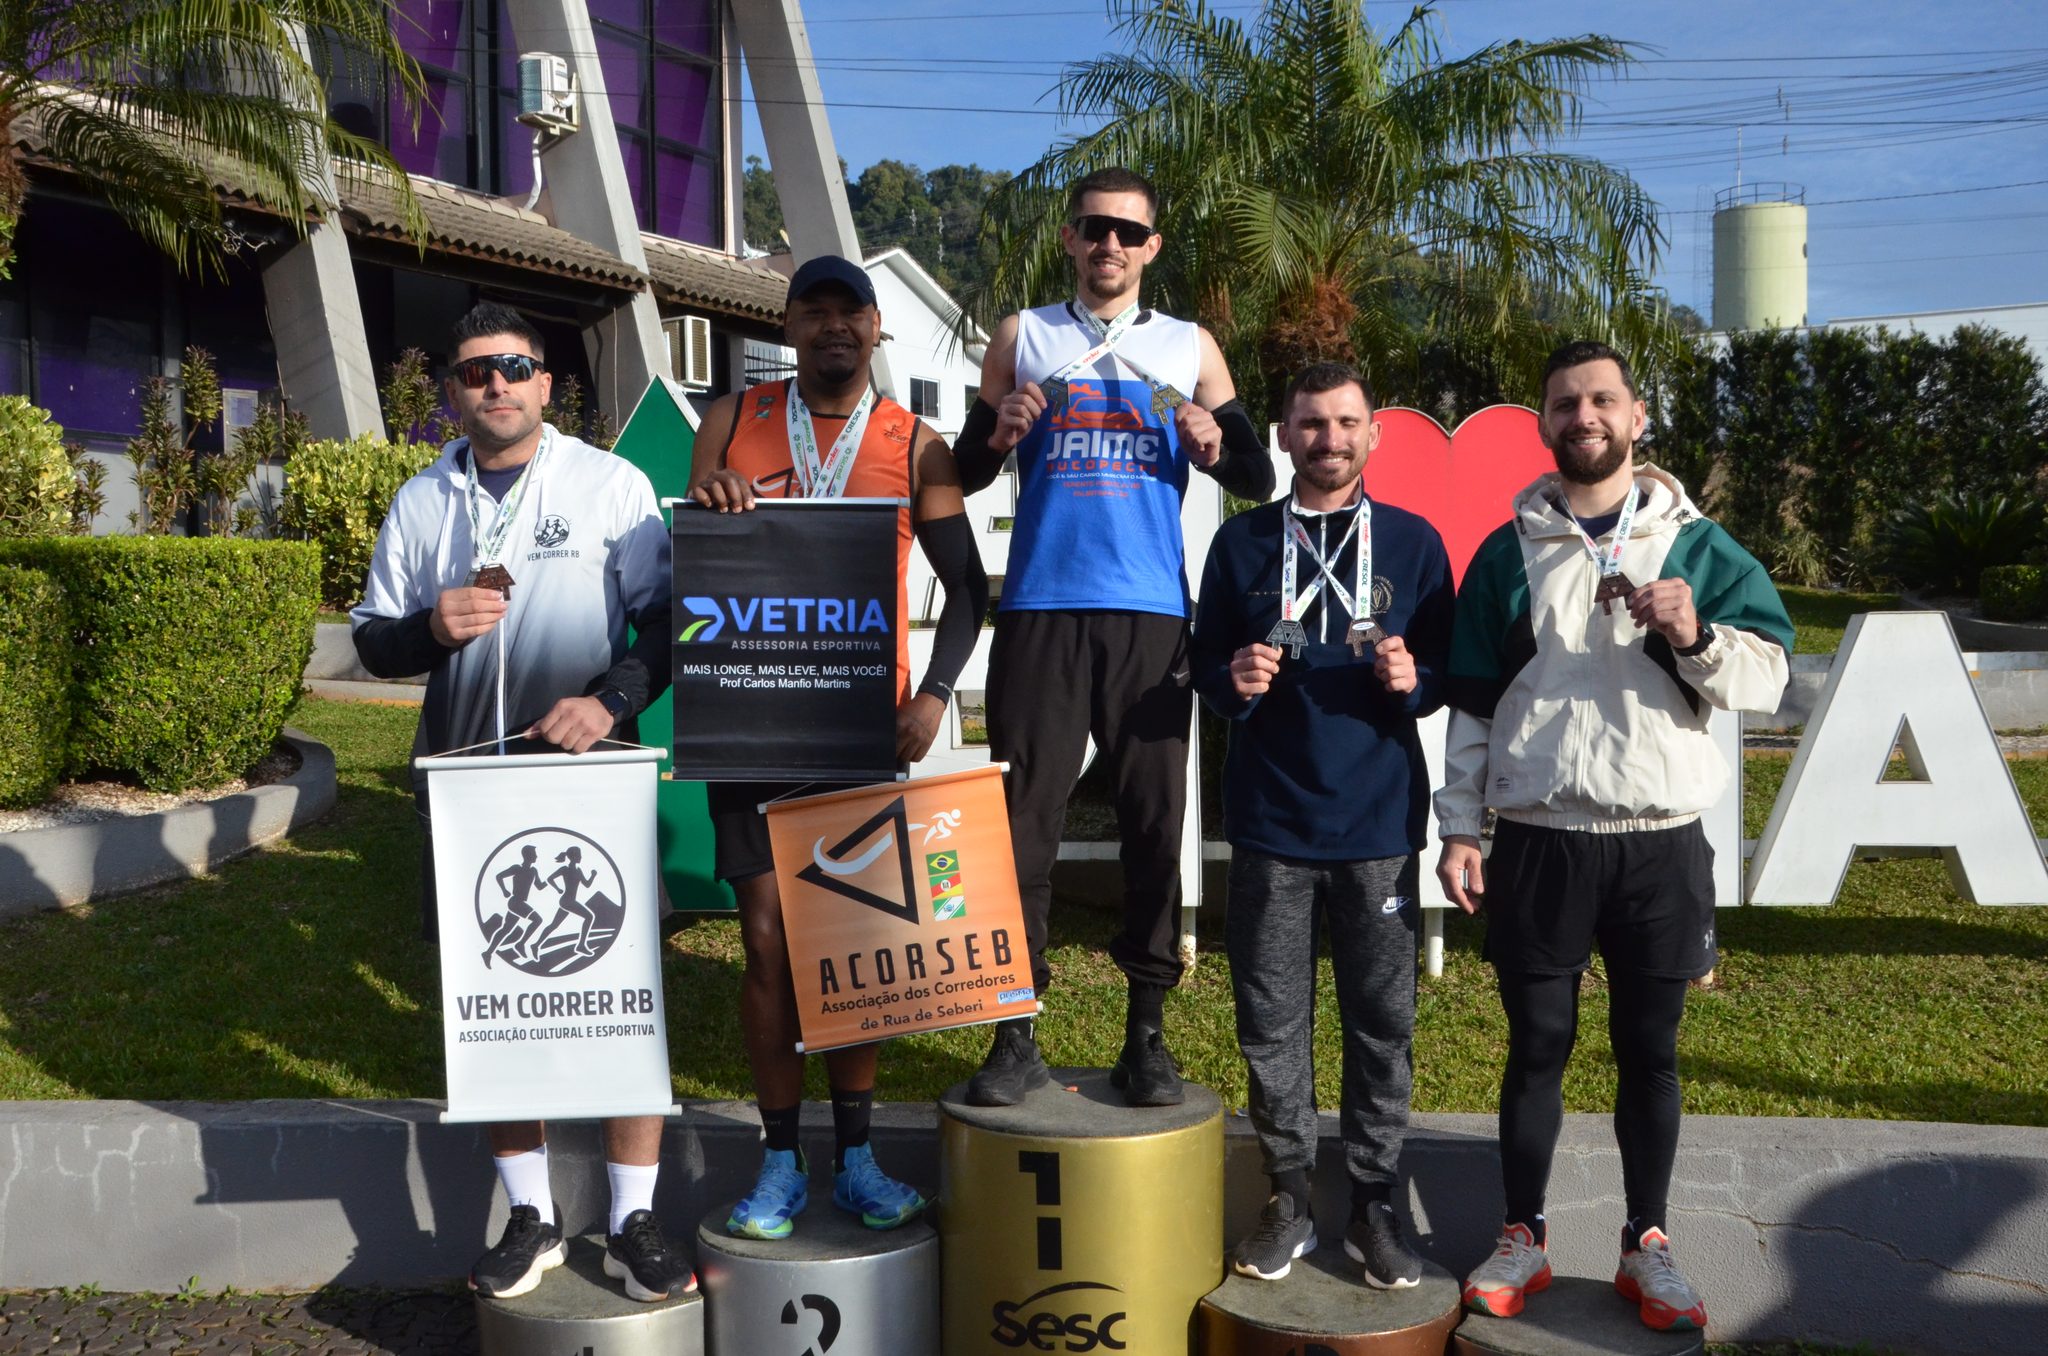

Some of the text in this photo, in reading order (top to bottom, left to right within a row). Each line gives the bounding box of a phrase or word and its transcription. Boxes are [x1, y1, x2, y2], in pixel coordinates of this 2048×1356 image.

[1046, 430, 1159, 462] JAIME
[527, 550, 580, 561] VEM CORRER RB
[728, 597, 890, 633] VETRIA
[731, 640, 881, 651] ASSESSORIA ESPORTIVA
[684, 664, 887, 677] MAIS LONGE, MAIS LEVE, MAIS VOCÊ!
[720, 678, 851, 689] Prof Carlos Manfio Martins
[819, 929, 1012, 996] ACORSEB
[457, 988, 654, 1021] VEM CORRER RB
[821, 973, 1016, 1015] Associação dos Corredores
[861, 999, 983, 1031] de Rua de Seberi
[459, 1024, 655, 1044] ASSOCIAÇÃO CULTURAL E ESPORTIVA
